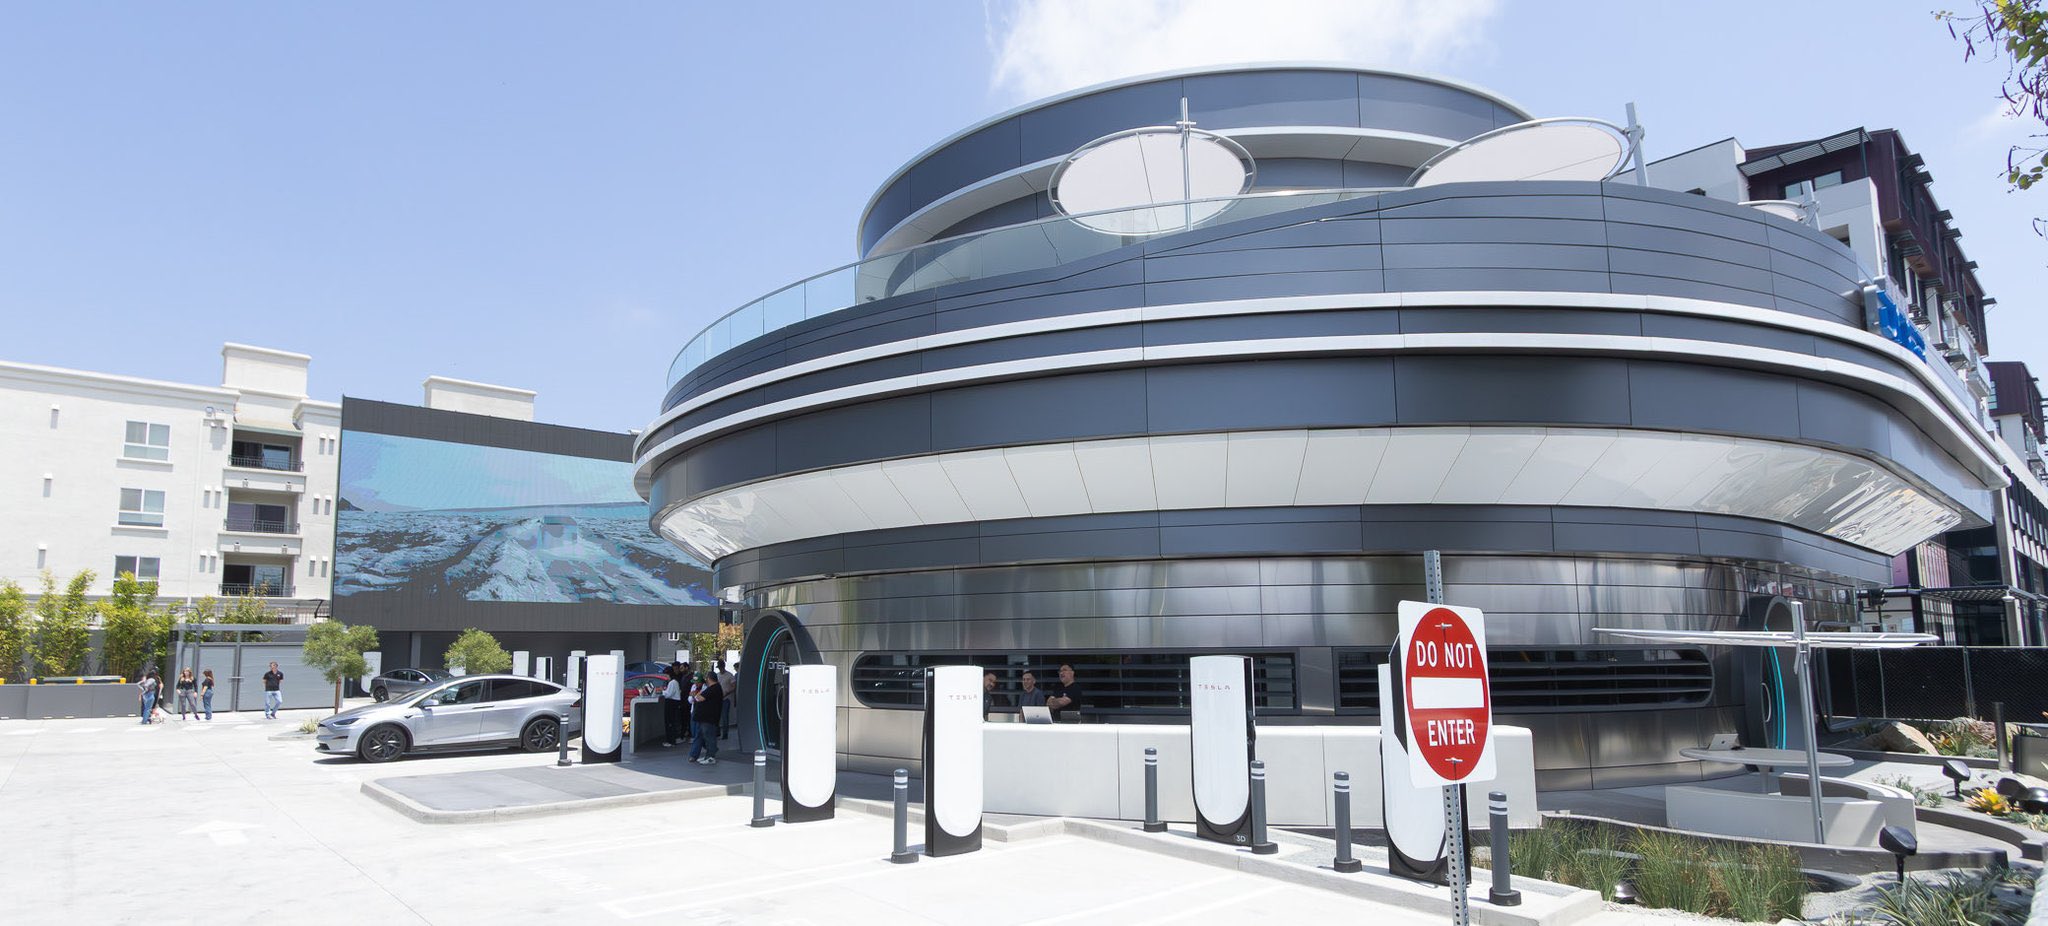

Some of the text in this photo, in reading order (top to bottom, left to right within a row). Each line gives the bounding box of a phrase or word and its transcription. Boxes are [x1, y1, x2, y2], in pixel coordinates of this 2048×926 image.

[1415, 640, 1474, 669] DO NOT
[1427, 718, 1476, 747] ENTER
[1236, 834, 1247, 843] 3D
